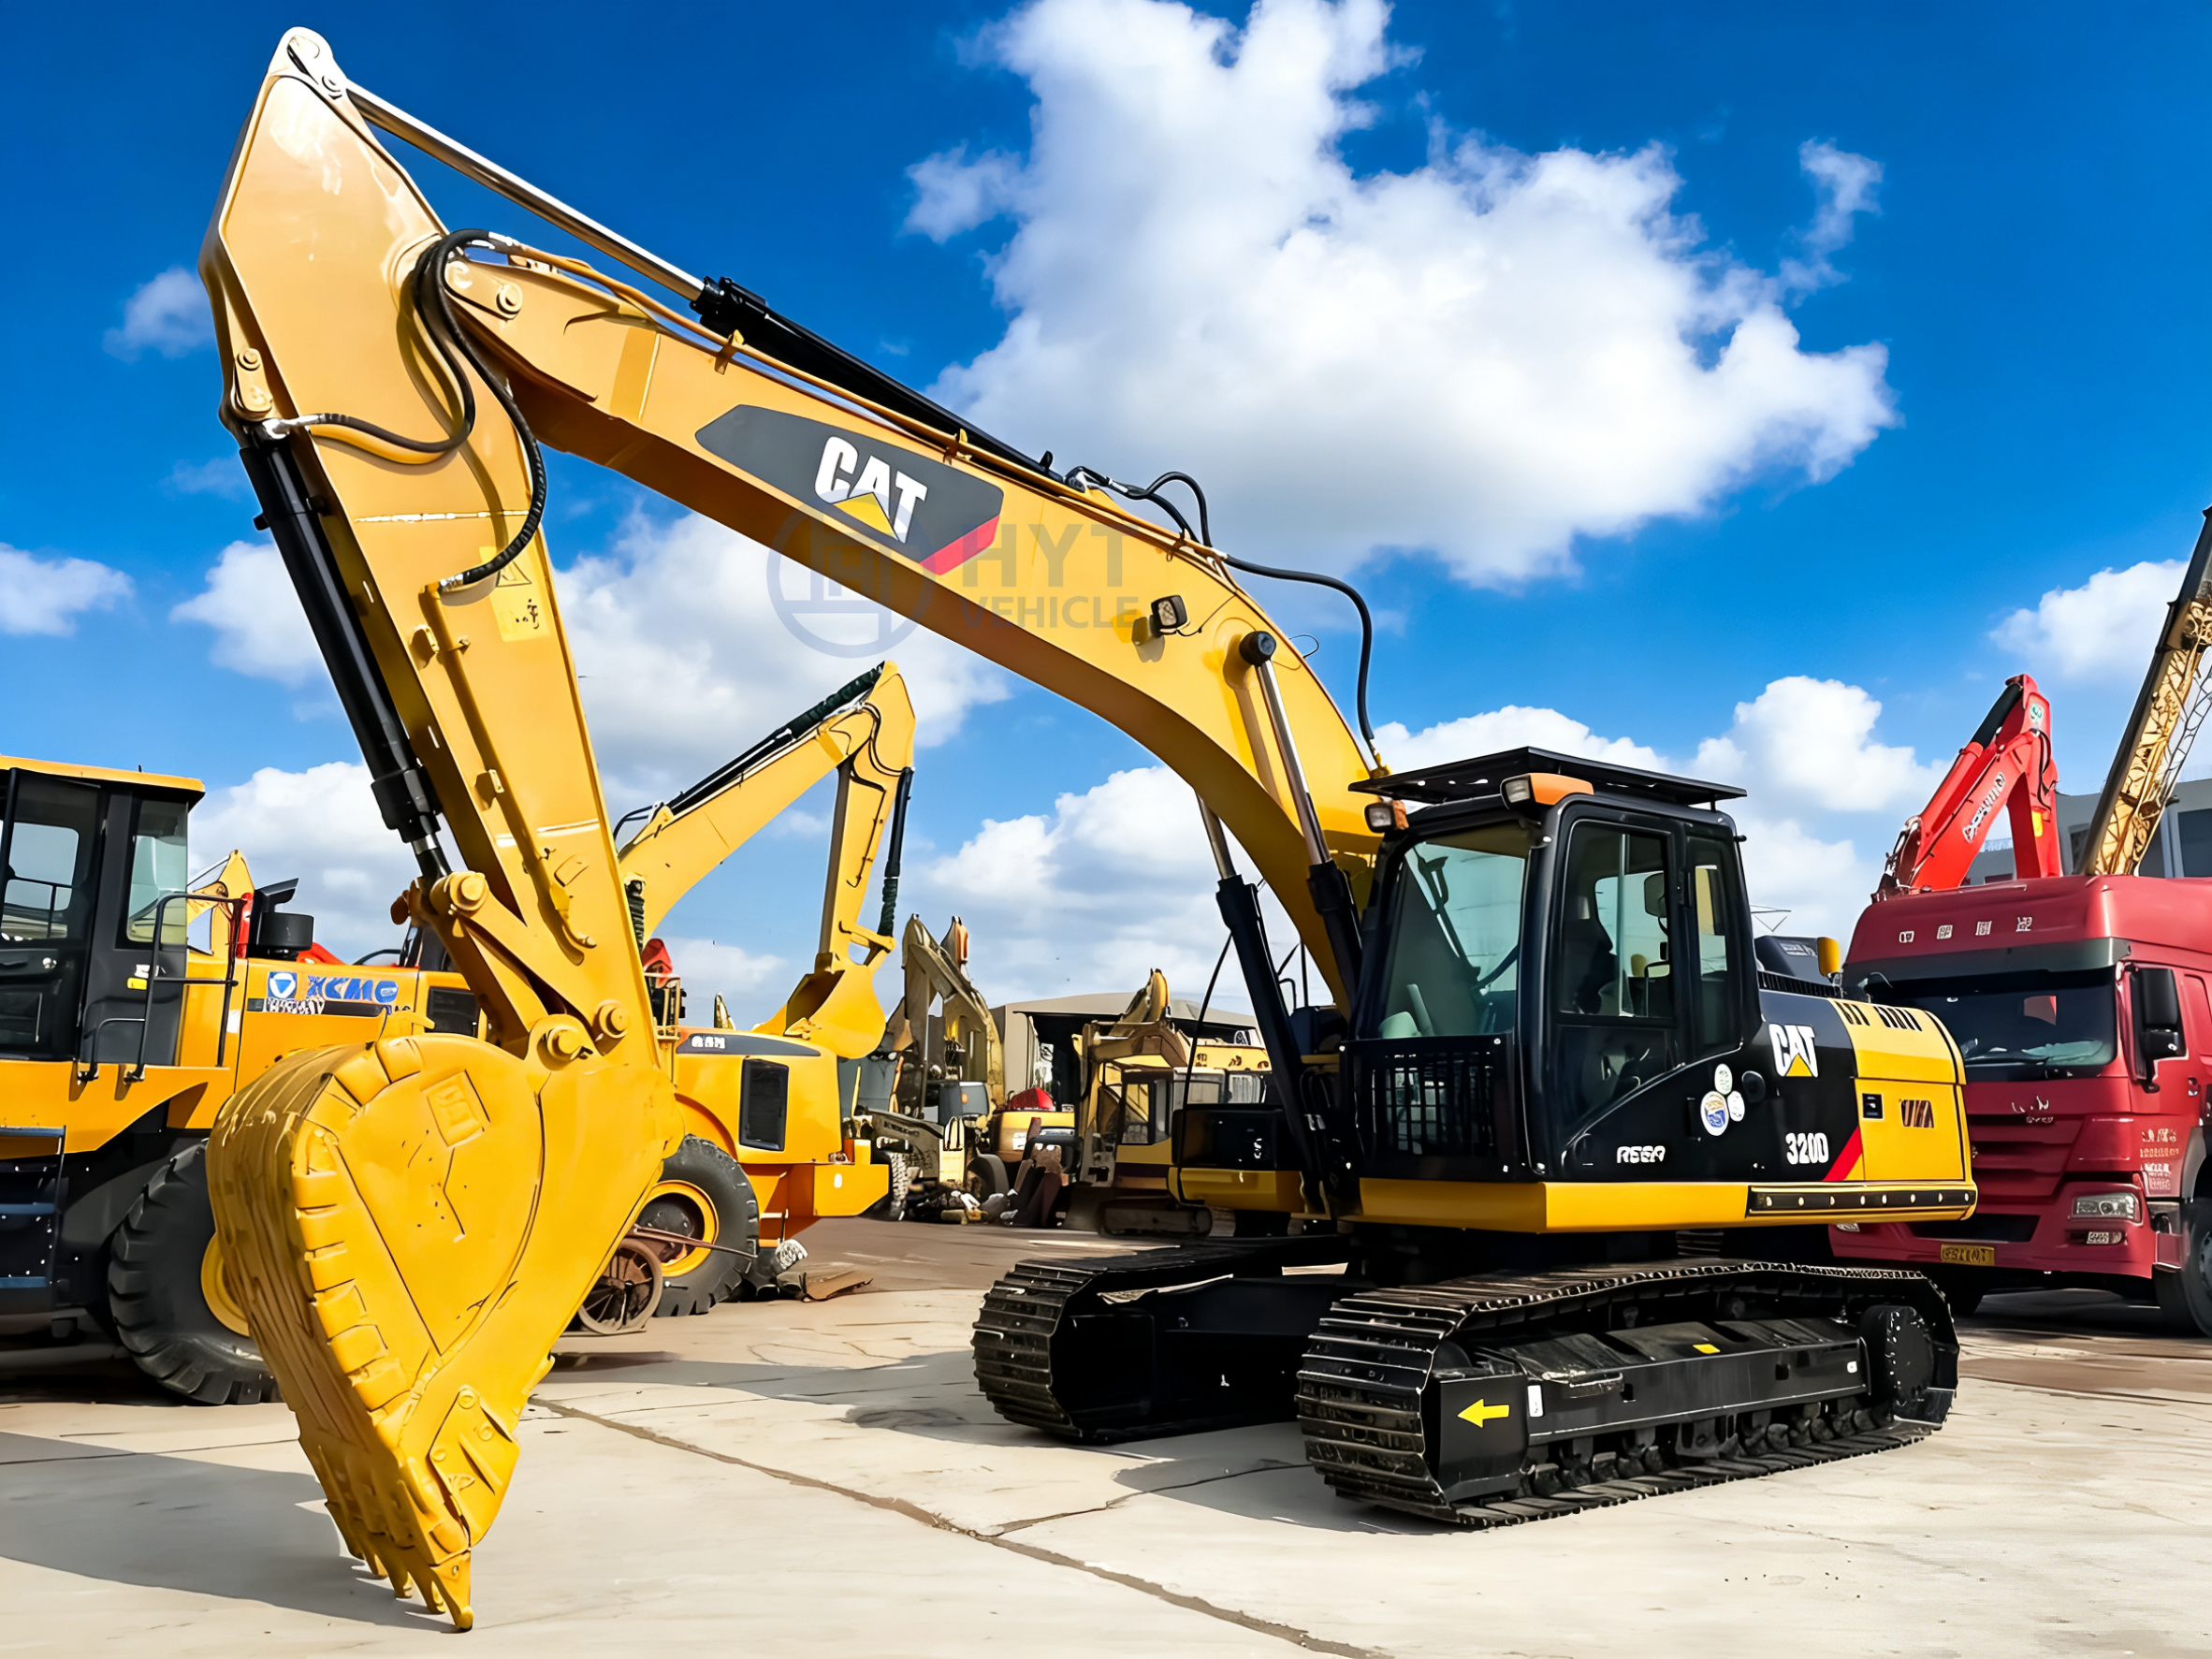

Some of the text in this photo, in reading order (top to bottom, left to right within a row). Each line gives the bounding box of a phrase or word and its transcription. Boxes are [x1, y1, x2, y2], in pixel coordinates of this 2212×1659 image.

[814, 436, 927, 543] CAT
[1768, 1024, 1818, 1078] CAT
[1785, 1132, 1828, 1165] 320D
